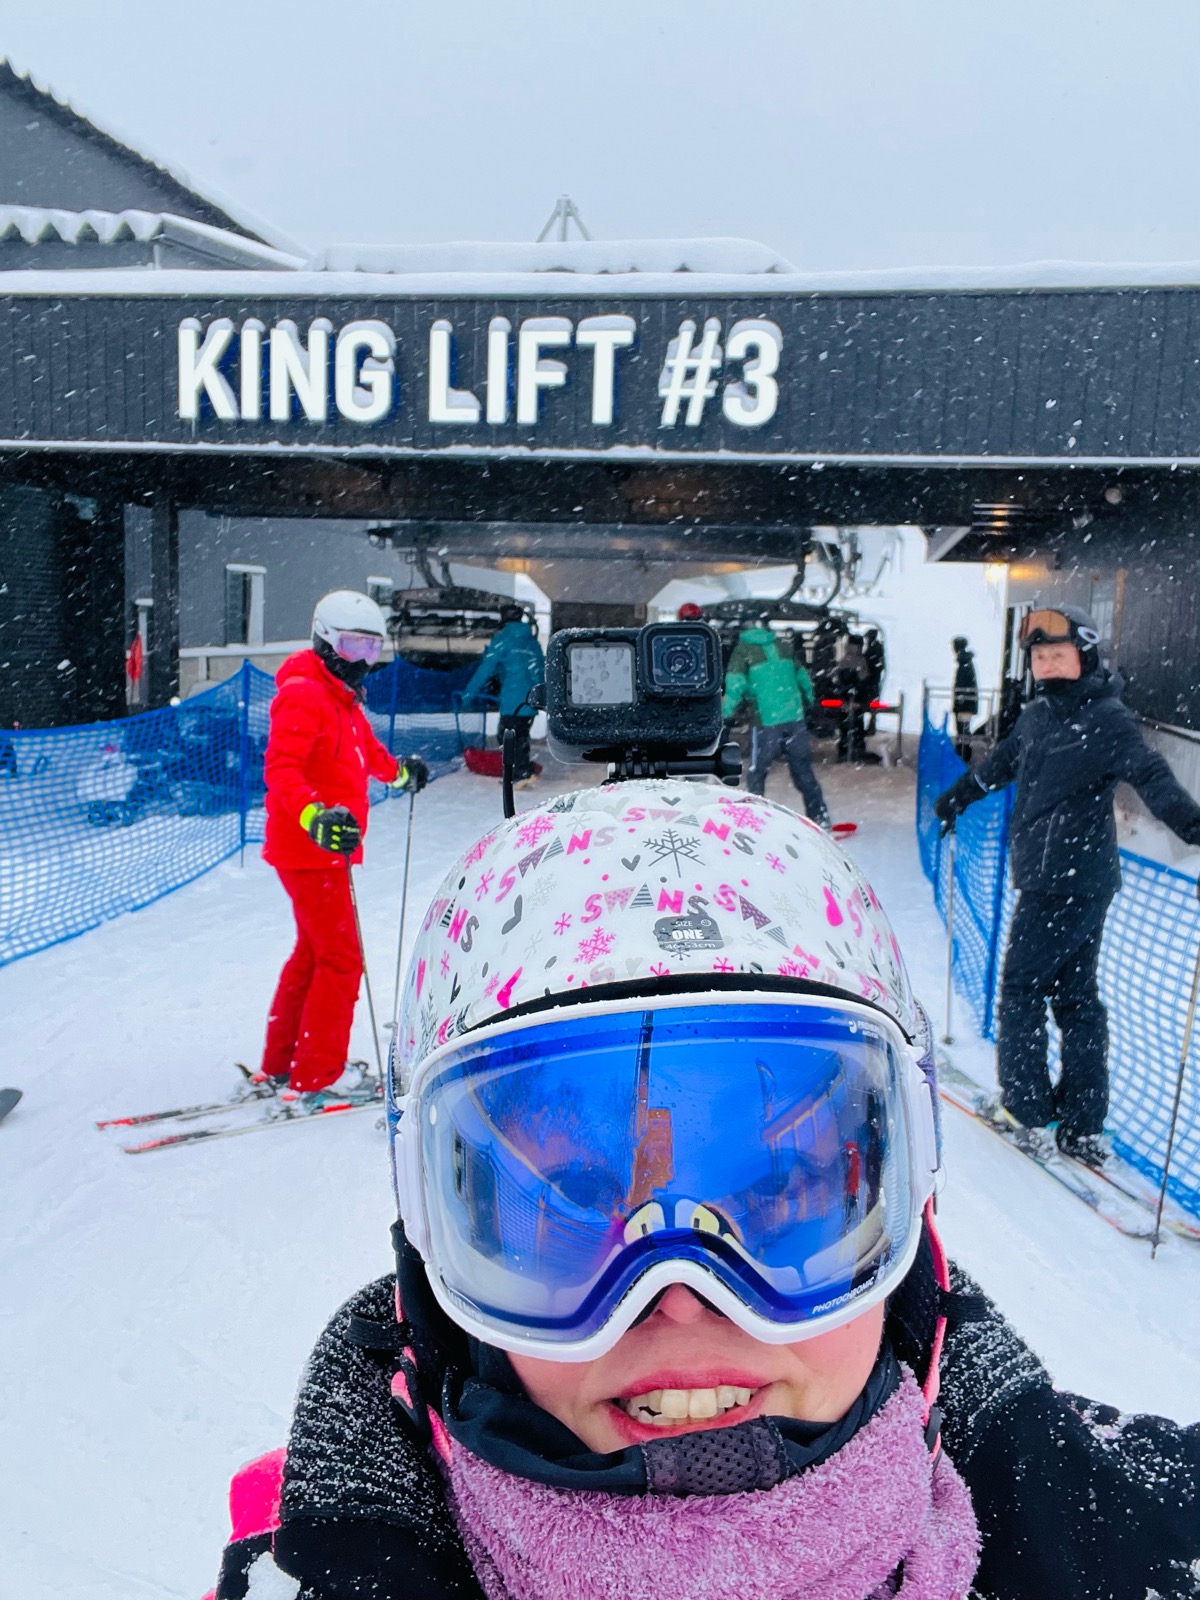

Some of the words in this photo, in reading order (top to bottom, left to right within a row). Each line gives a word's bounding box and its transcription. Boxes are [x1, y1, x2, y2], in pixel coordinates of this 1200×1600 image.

[178, 320, 396, 424] KING
[428, 317, 636, 425] LIFT
[659, 319, 782, 427] #3
[621, 806, 757, 856] SWANS
[494, 826, 618, 904] SWANS
[580, 882, 710, 924] SWANS
[672, 928, 705, 940] ONE
[811, 1276, 875, 1315] PHOTOCHROMIC
